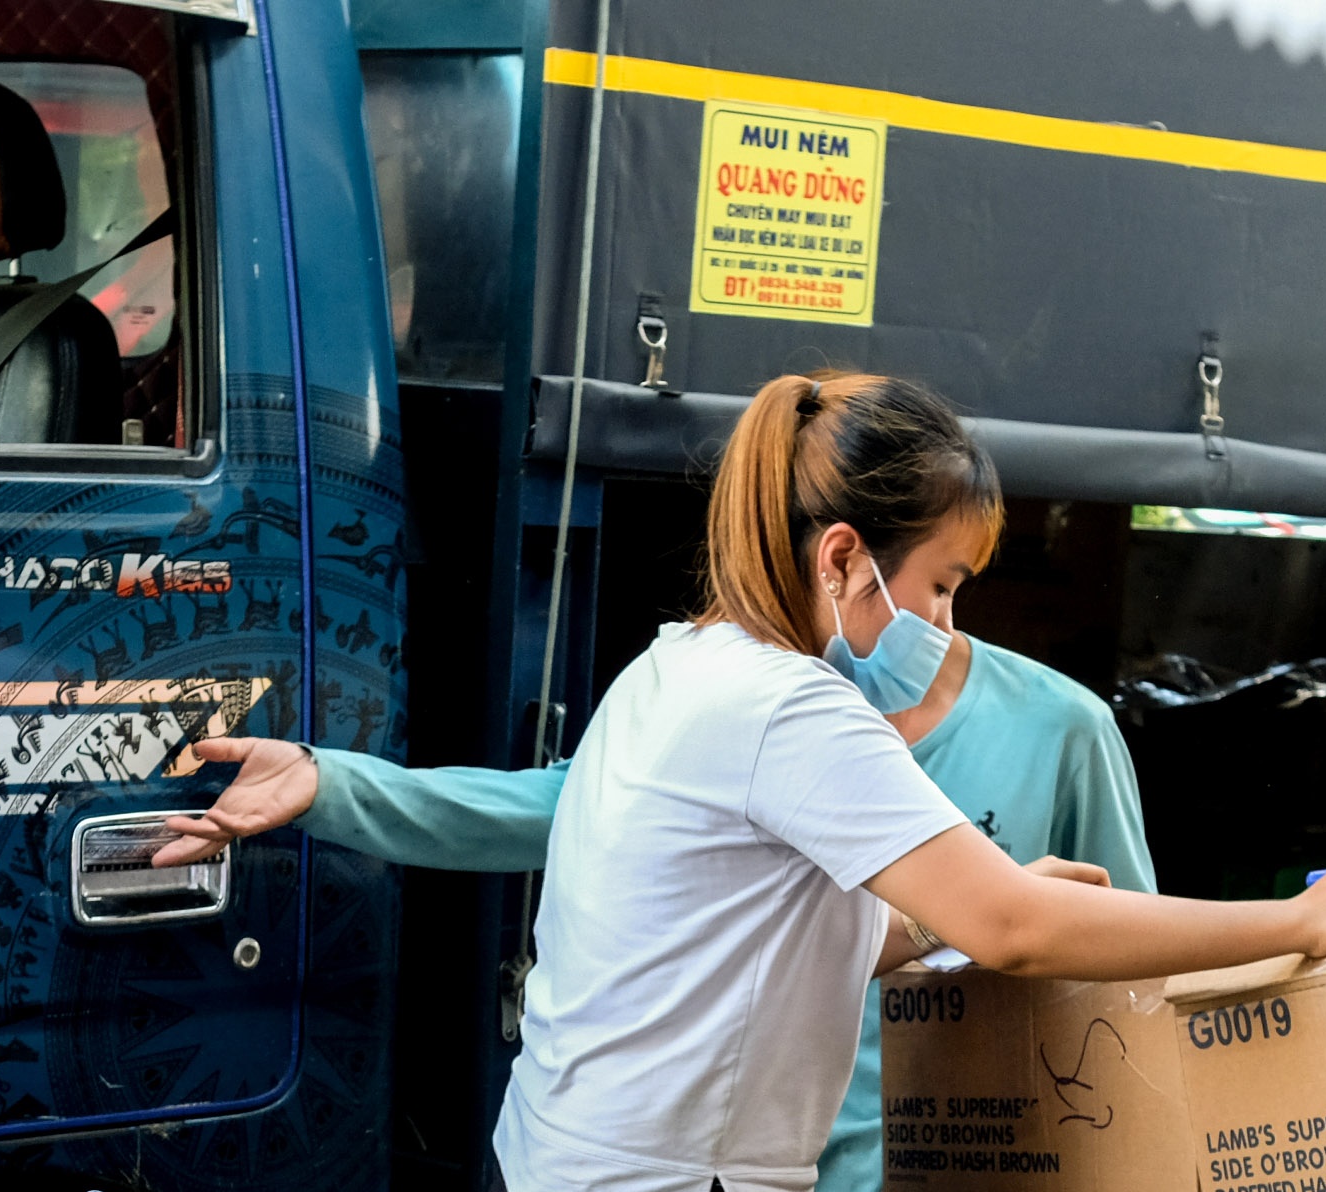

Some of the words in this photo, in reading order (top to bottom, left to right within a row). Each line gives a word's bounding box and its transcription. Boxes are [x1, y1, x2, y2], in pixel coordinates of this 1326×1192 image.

[740, 124, 789, 150] MUI
[717, 162, 797, 198] QUANG
[803, 166, 866, 204] DŨNG
[884, 985, 965, 1022] G0019
[1188, 997, 1292, 1050] G0019
[887, 1099, 937, 1118] LAMB'S
[887, 1125, 917, 1144] SIDE
[923, 1125, 1015, 1145] O'BROWNS
[1206, 1124, 1276, 1154] LAMB'S
[952, 1151, 995, 1172] HASH
[1000, 1152, 1059, 1174] BROWN
[1210, 1156, 1254, 1182] SIDE
